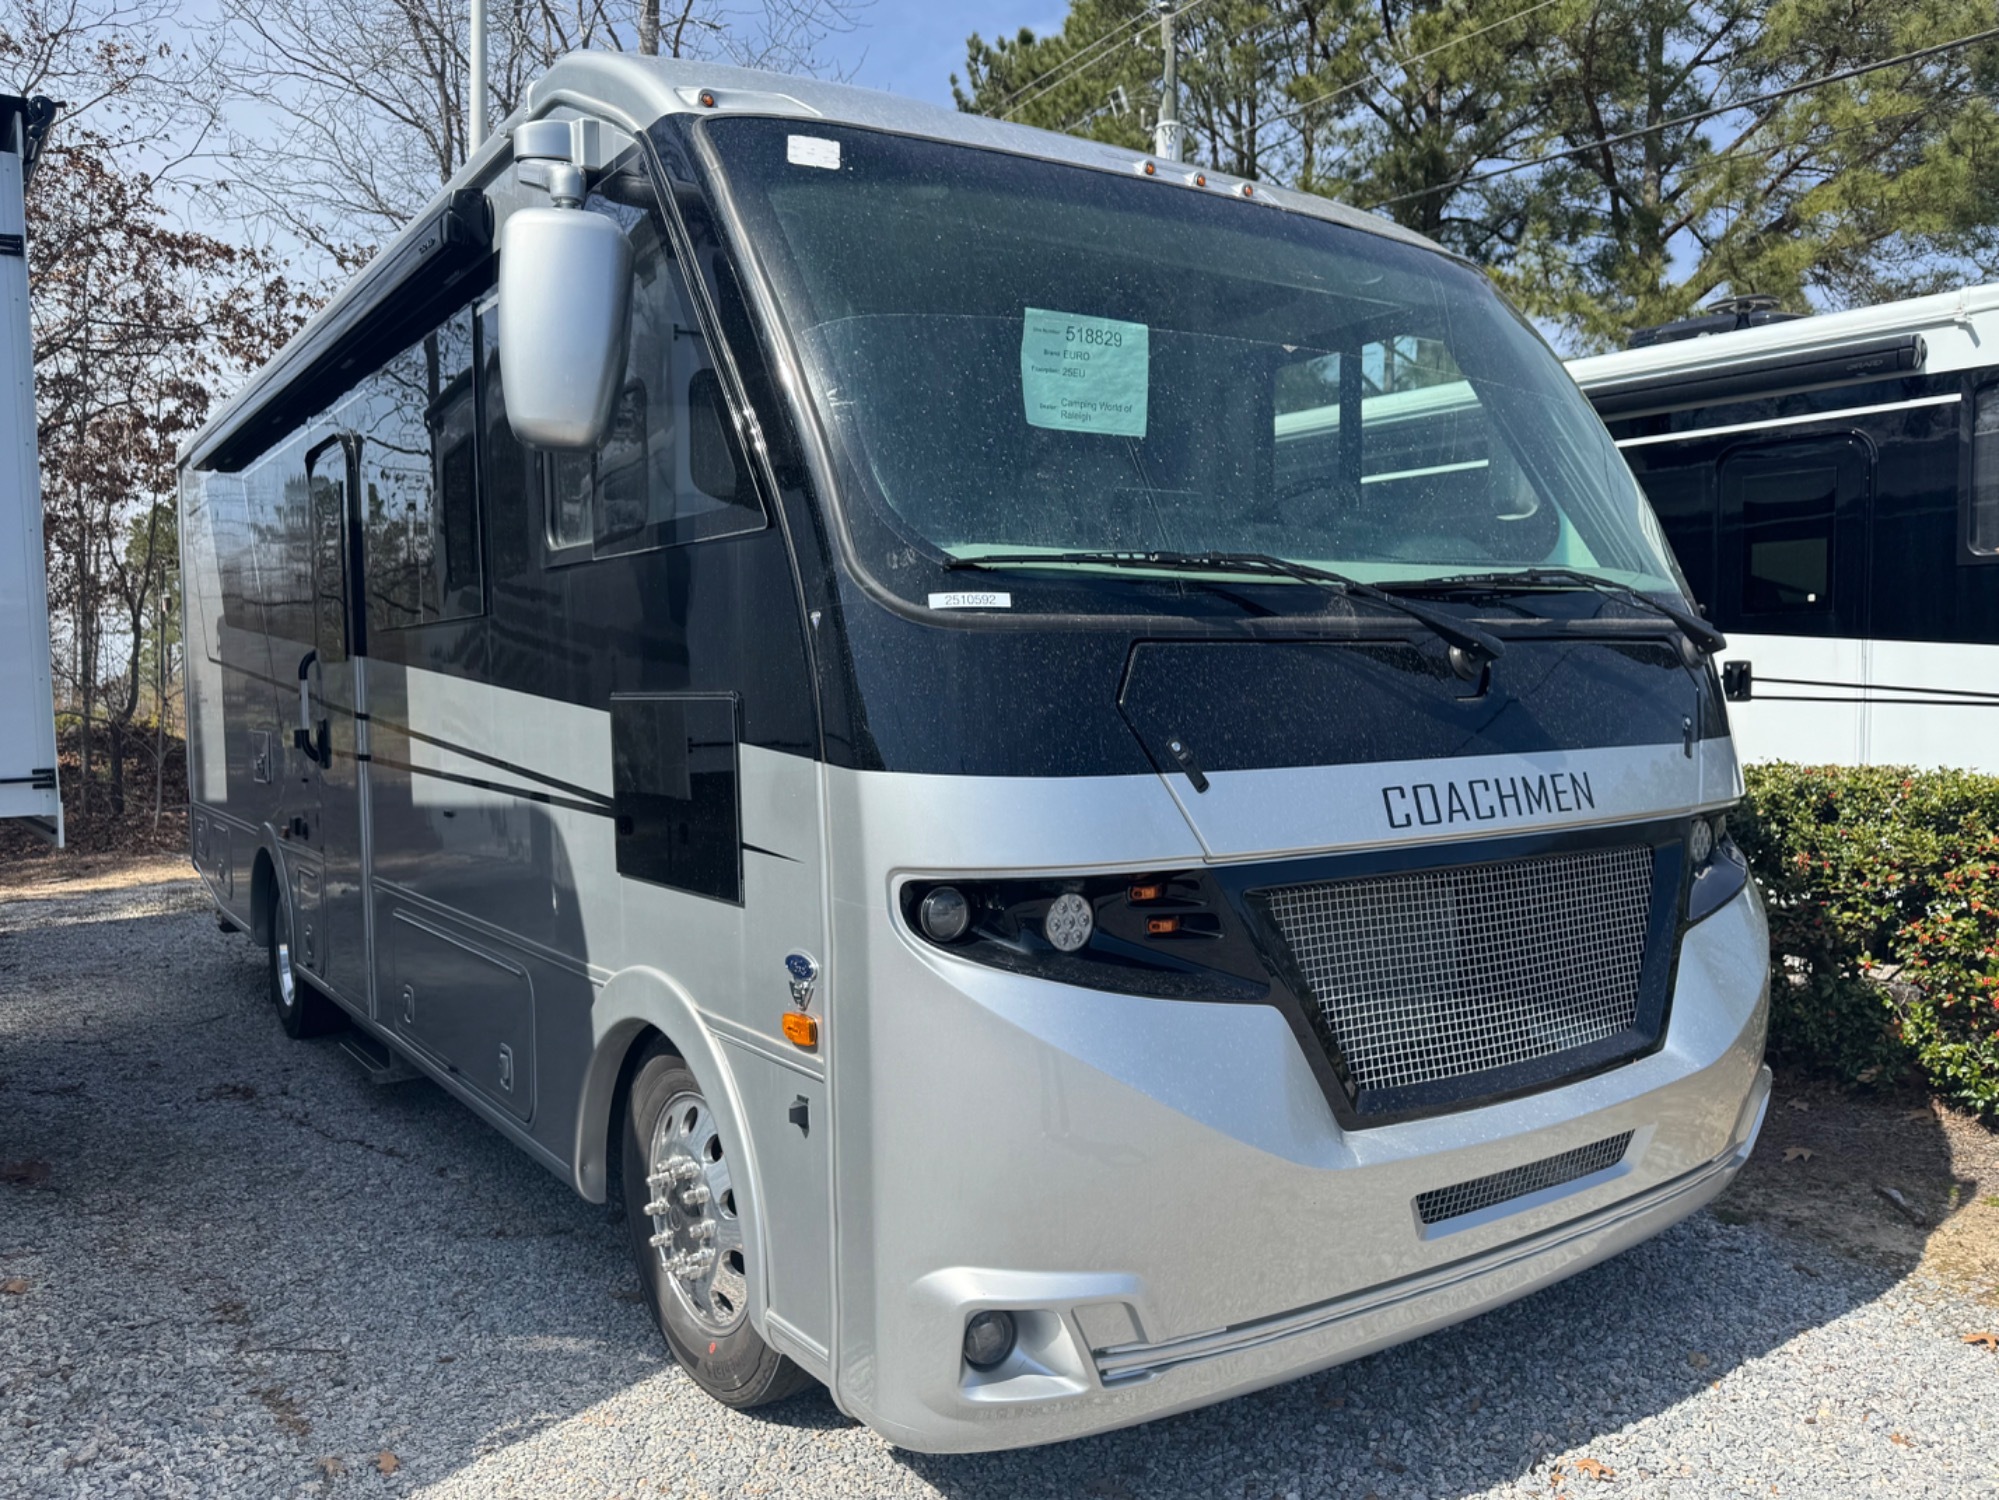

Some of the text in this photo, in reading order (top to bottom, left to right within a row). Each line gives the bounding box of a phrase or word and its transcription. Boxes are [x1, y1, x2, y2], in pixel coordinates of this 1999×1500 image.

[1066, 326, 1122, 347] 518829
[1063, 350, 1090, 360] EURO
[1062, 367, 1086, 378] 25EU
[1061, 398, 1097, 411] Camping
[1099, 401, 1122, 413] World
[1123, 404, 1133, 413] of
[1061, 410, 1091, 423] Raleigh
[944, 594, 996, 605] 2510592
[1381, 771, 1596, 829] COACHMEN
